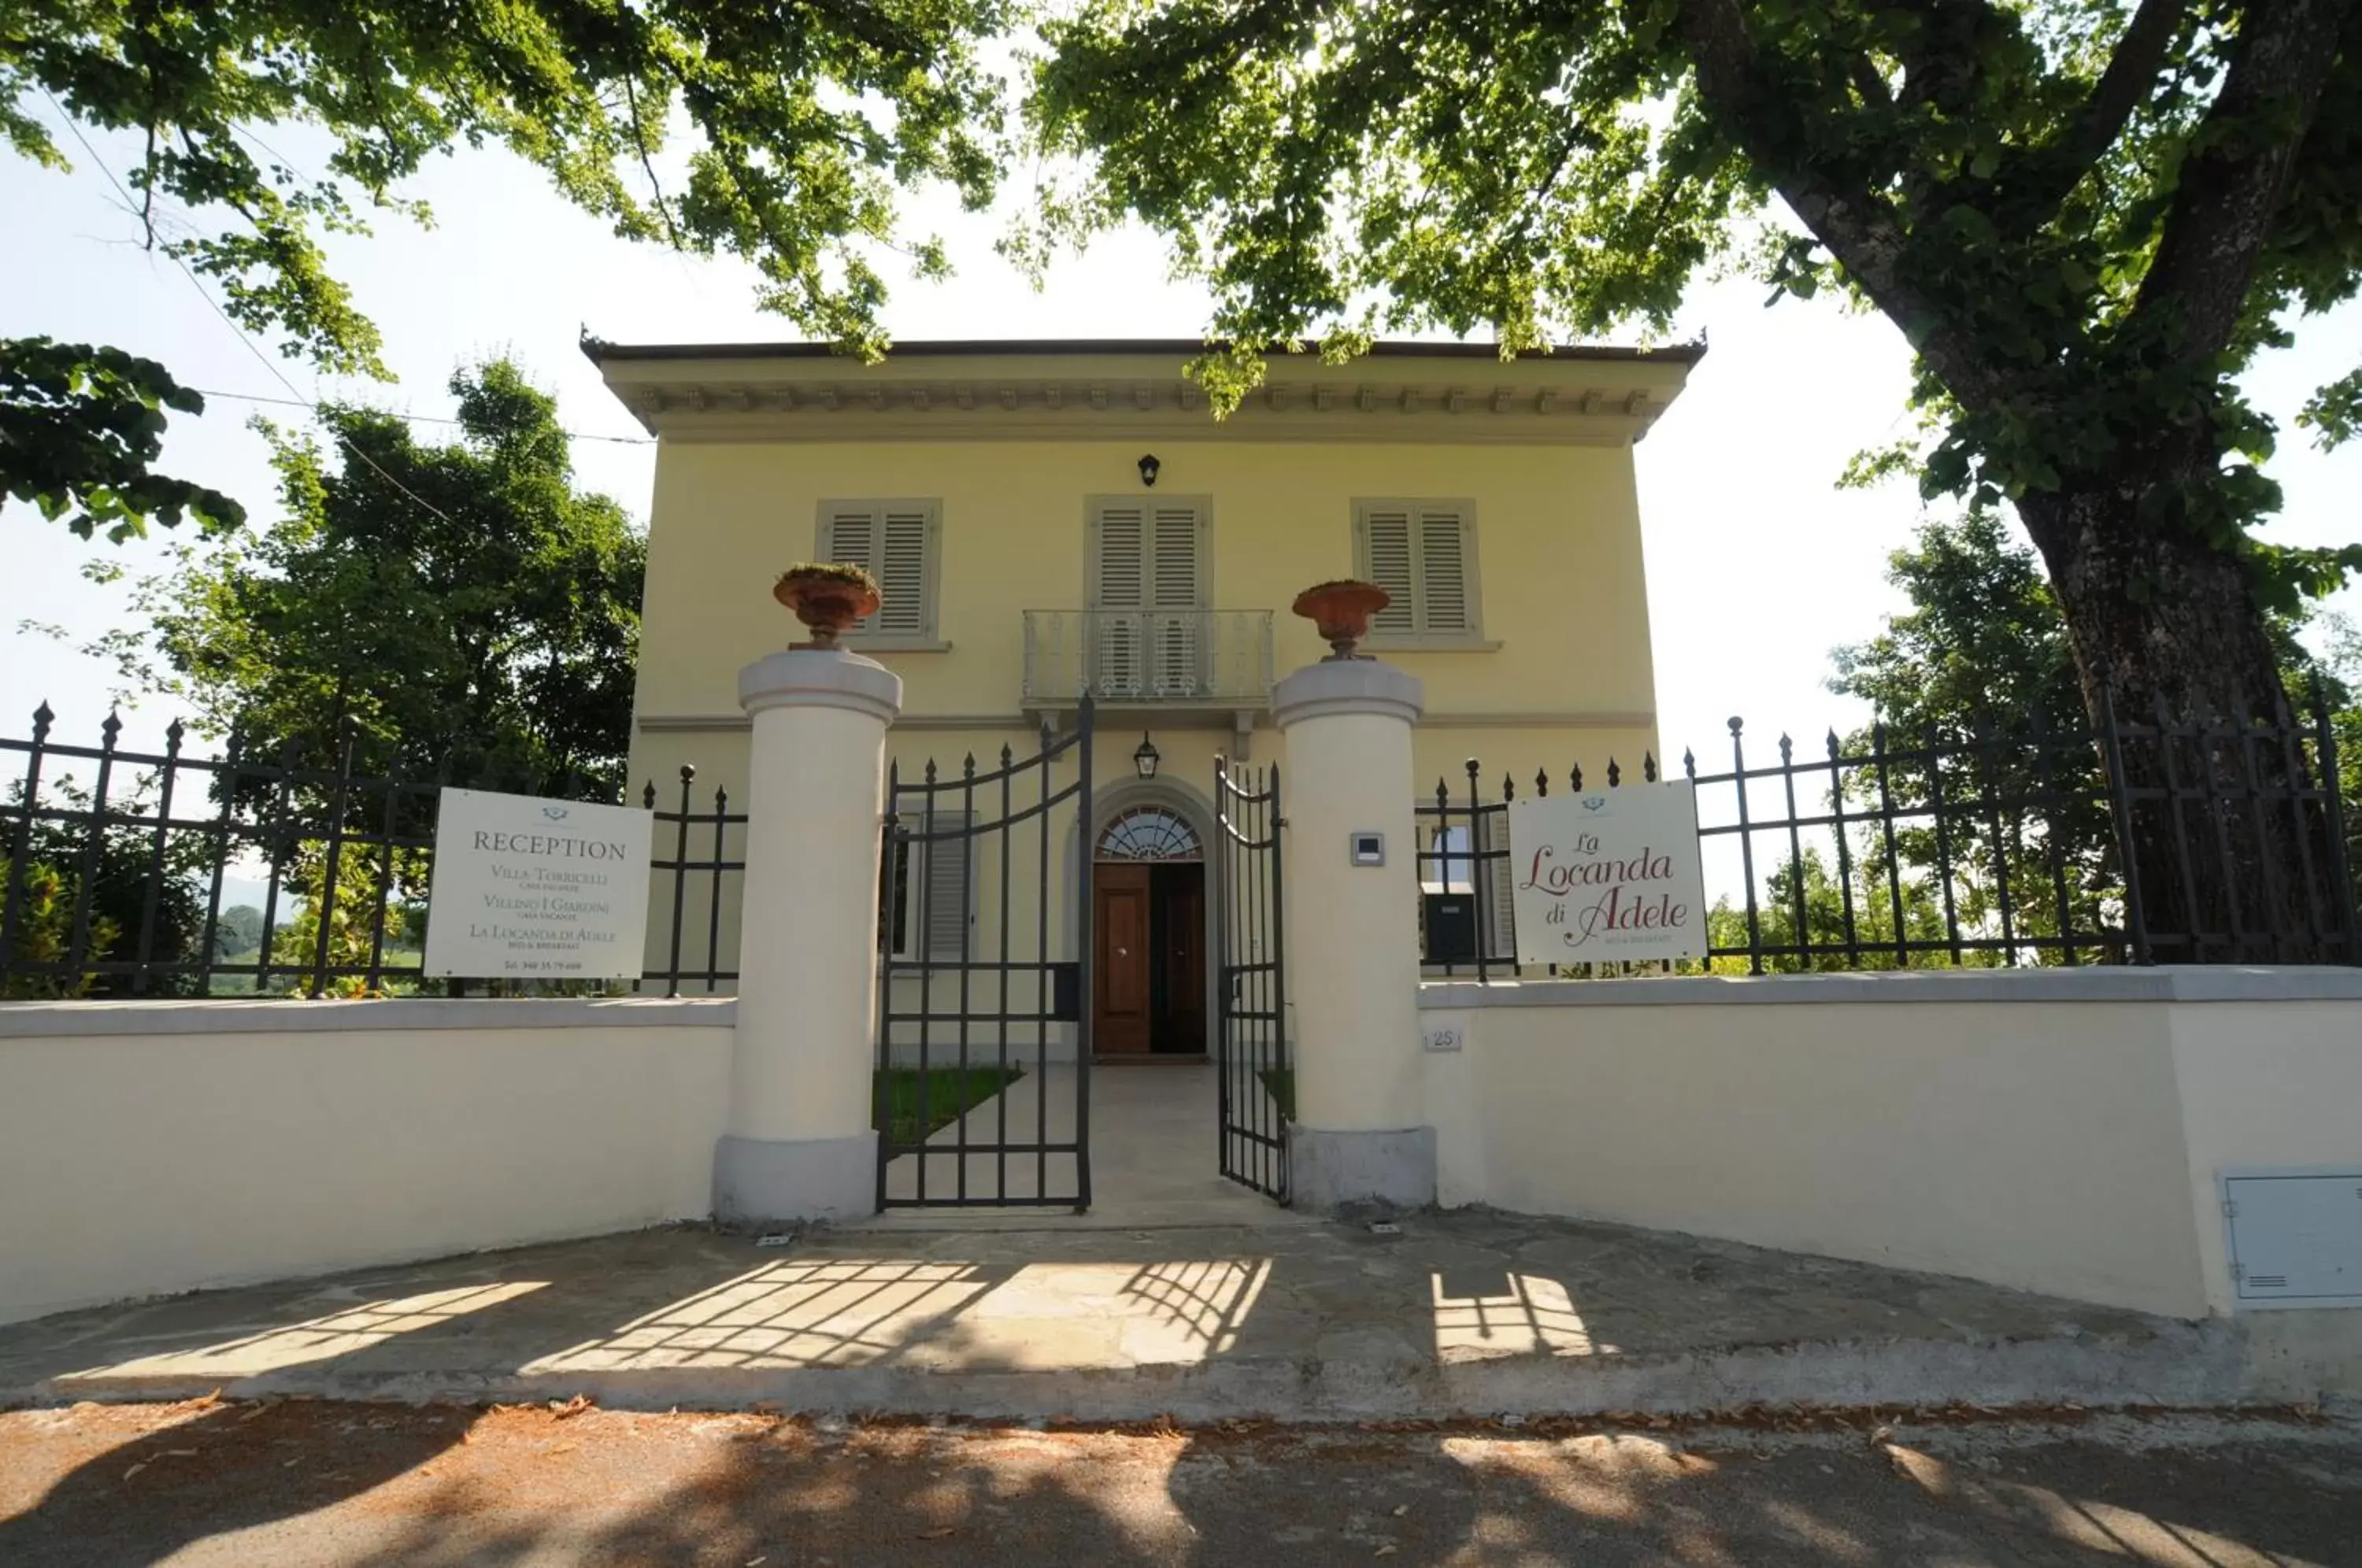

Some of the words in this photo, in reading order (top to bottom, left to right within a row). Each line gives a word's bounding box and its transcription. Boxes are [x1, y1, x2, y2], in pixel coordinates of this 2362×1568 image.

[473, 830, 627, 860] RECEPTION
[1575, 833, 1600, 855] La
[1520, 845, 1674, 896] Locanda
[1546, 903, 1566, 925] di
[1563, 886, 1687, 947] Adele
[1434, 1030, 1453, 1046] 25
